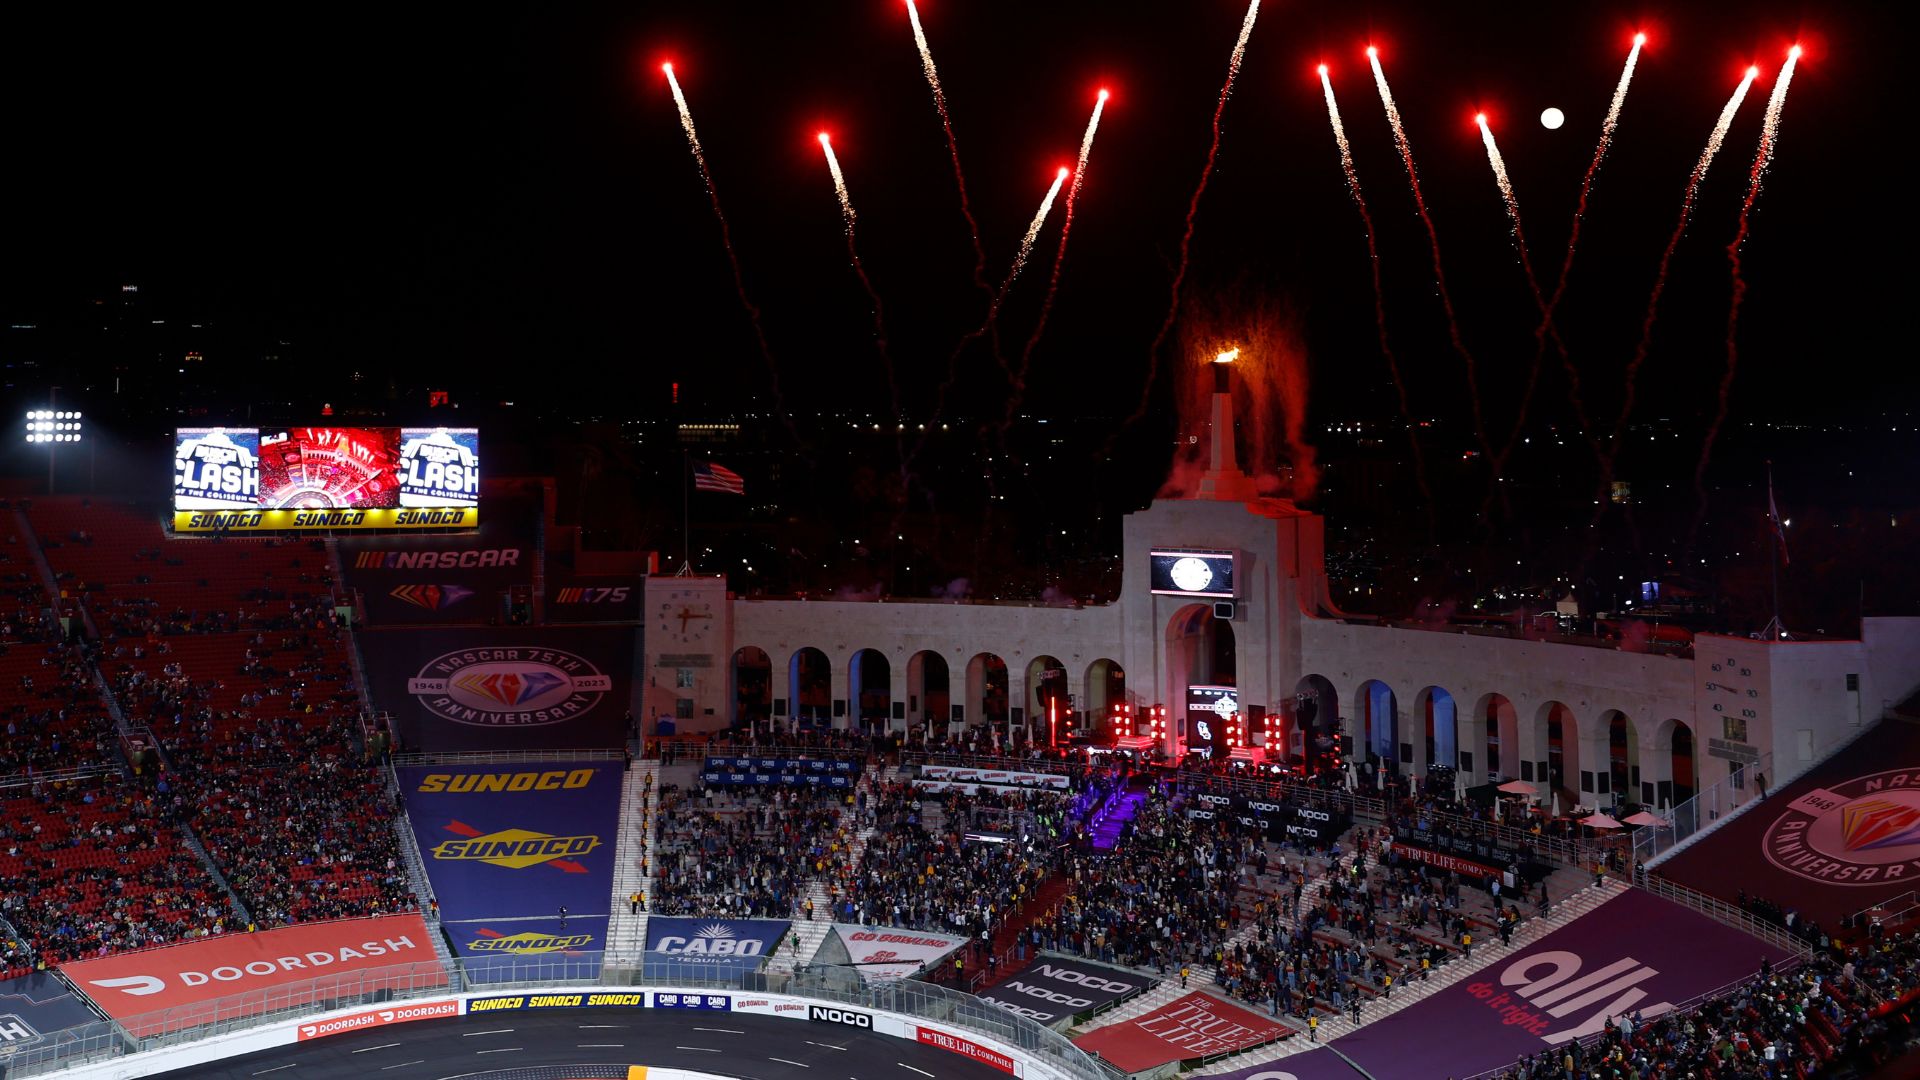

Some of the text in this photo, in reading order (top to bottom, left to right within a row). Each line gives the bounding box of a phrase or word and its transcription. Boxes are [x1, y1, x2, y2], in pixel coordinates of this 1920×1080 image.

[188, 513, 263, 528] SUNOCO
[293, 512, 366, 527] SUNOCO
[395, 511, 465, 525] SUNOCO
[396, 549, 519, 569] NASCAR
[593, 587, 631, 603] 75
[436, 650, 582, 673] NASCAR 75TH
[414, 682, 442, 690] 1948
[433, 694, 589, 724] ANNIVERSARY
[418, 768, 595, 793] SUNOCO
[1198, 794, 1230, 805] NOCO
[1298, 809, 1329, 821] NOCO
[1802, 795, 1835, 810] 1948
[437, 836, 592, 857] SUNOCO
[1433, 854, 1456, 870] LIFE
[473, 935, 591, 950] SUNOCO
[655, 936, 763, 957] CABO
[849, 932, 950, 948] GO BOWLING
[179, 935, 417, 987] DOORDASH
[1031, 964, 1133, 994] NOCO
[470, 994, 641, 1012] SUNOCO SUNOCO SUNOCO
[659, 994, 726, 1006] CABO CABO CABO
[1005, 981, 1093, 1008] NOCO
[1466, 982, 1493, 999] do
[1486, 991, 1511, 1009] it
[1500, 950, 1680, 1045] ally
[319, 1004, 455, 1033] DOORDASH DOORDASH
[774, 1004, 783, 1012] GO
[813, 1007, 869, 1028] NOCO
[982, 996, 1055, 1021] NOCO
[1165, 1002, 1256, 1043] TRUE
[1134, 1014, 1225, 1053] LIFE
[921, 1032, 1013, 1069] THE TRUE LIFE COMPANIES
